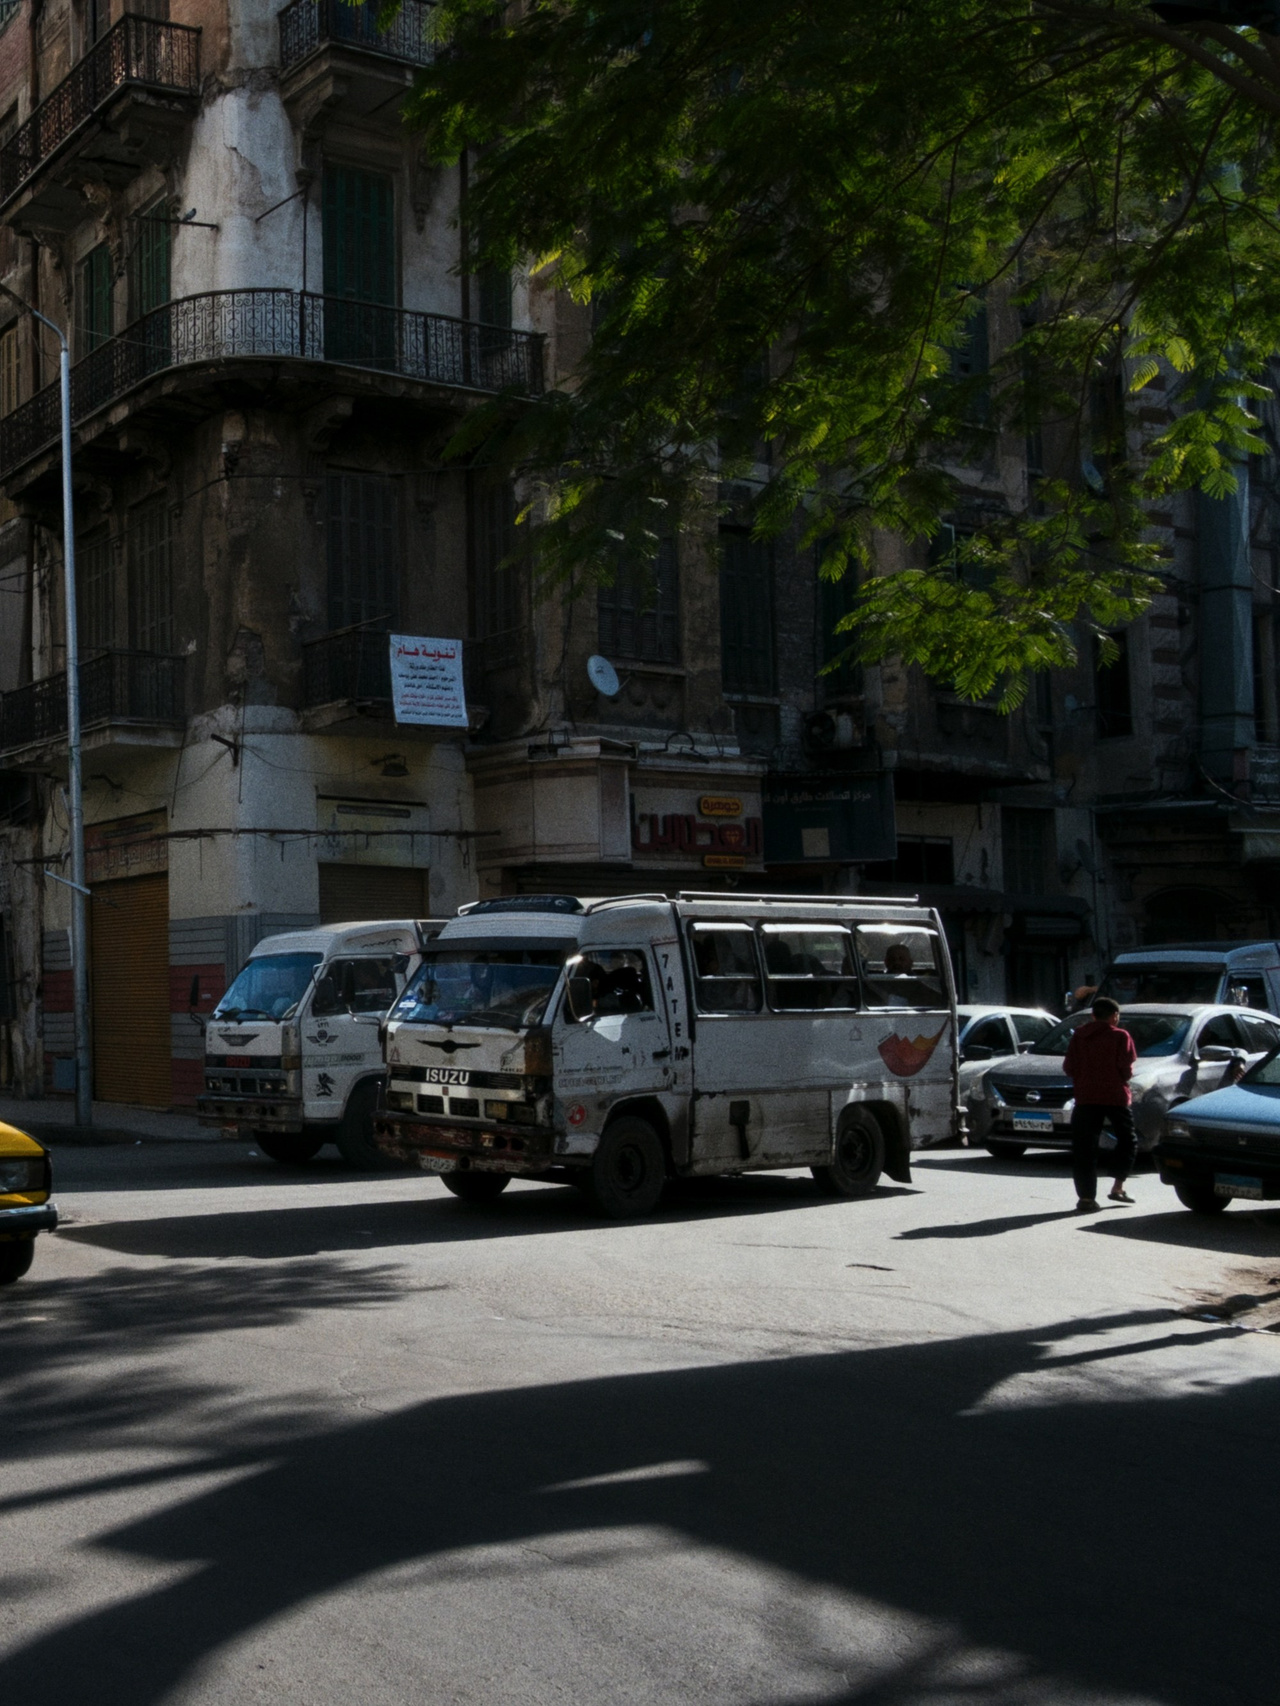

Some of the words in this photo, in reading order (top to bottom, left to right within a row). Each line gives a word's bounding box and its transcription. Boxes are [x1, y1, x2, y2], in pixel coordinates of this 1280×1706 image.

[397, 645, 420, 658] هام
[702, 799, 740, 813] جوهرة
[425, 1067, 470, 1085] ISUZU
